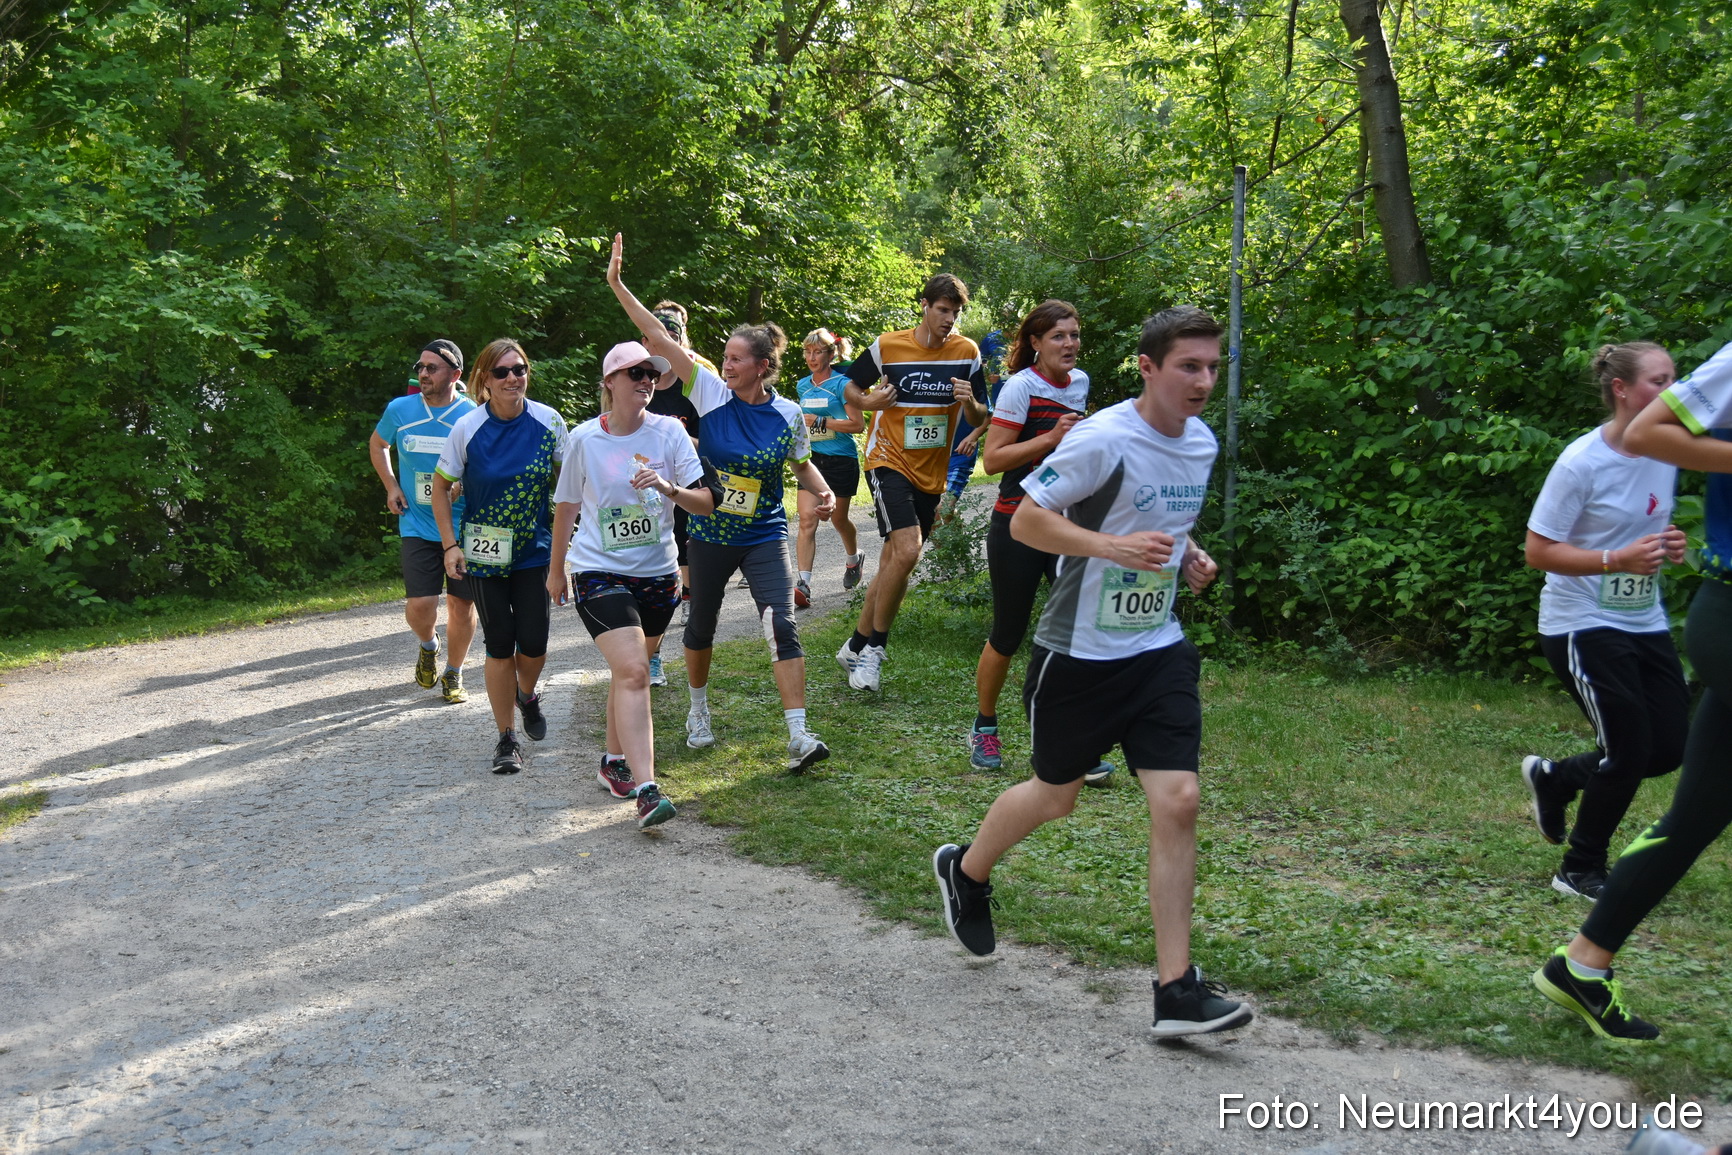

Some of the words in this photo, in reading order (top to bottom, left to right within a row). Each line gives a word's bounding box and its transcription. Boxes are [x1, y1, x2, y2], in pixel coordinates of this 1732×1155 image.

[910, 381, 955, 391] Fische
[914, 427, 938, 440] 785
[724, 486, 746, 505] 73
[608, 518, 652, 538] 1360
[472, 538, 500, 555] 224
[1610, 575, 1653, 597] 1315
[1111, 591, 1165, 614] 1008
